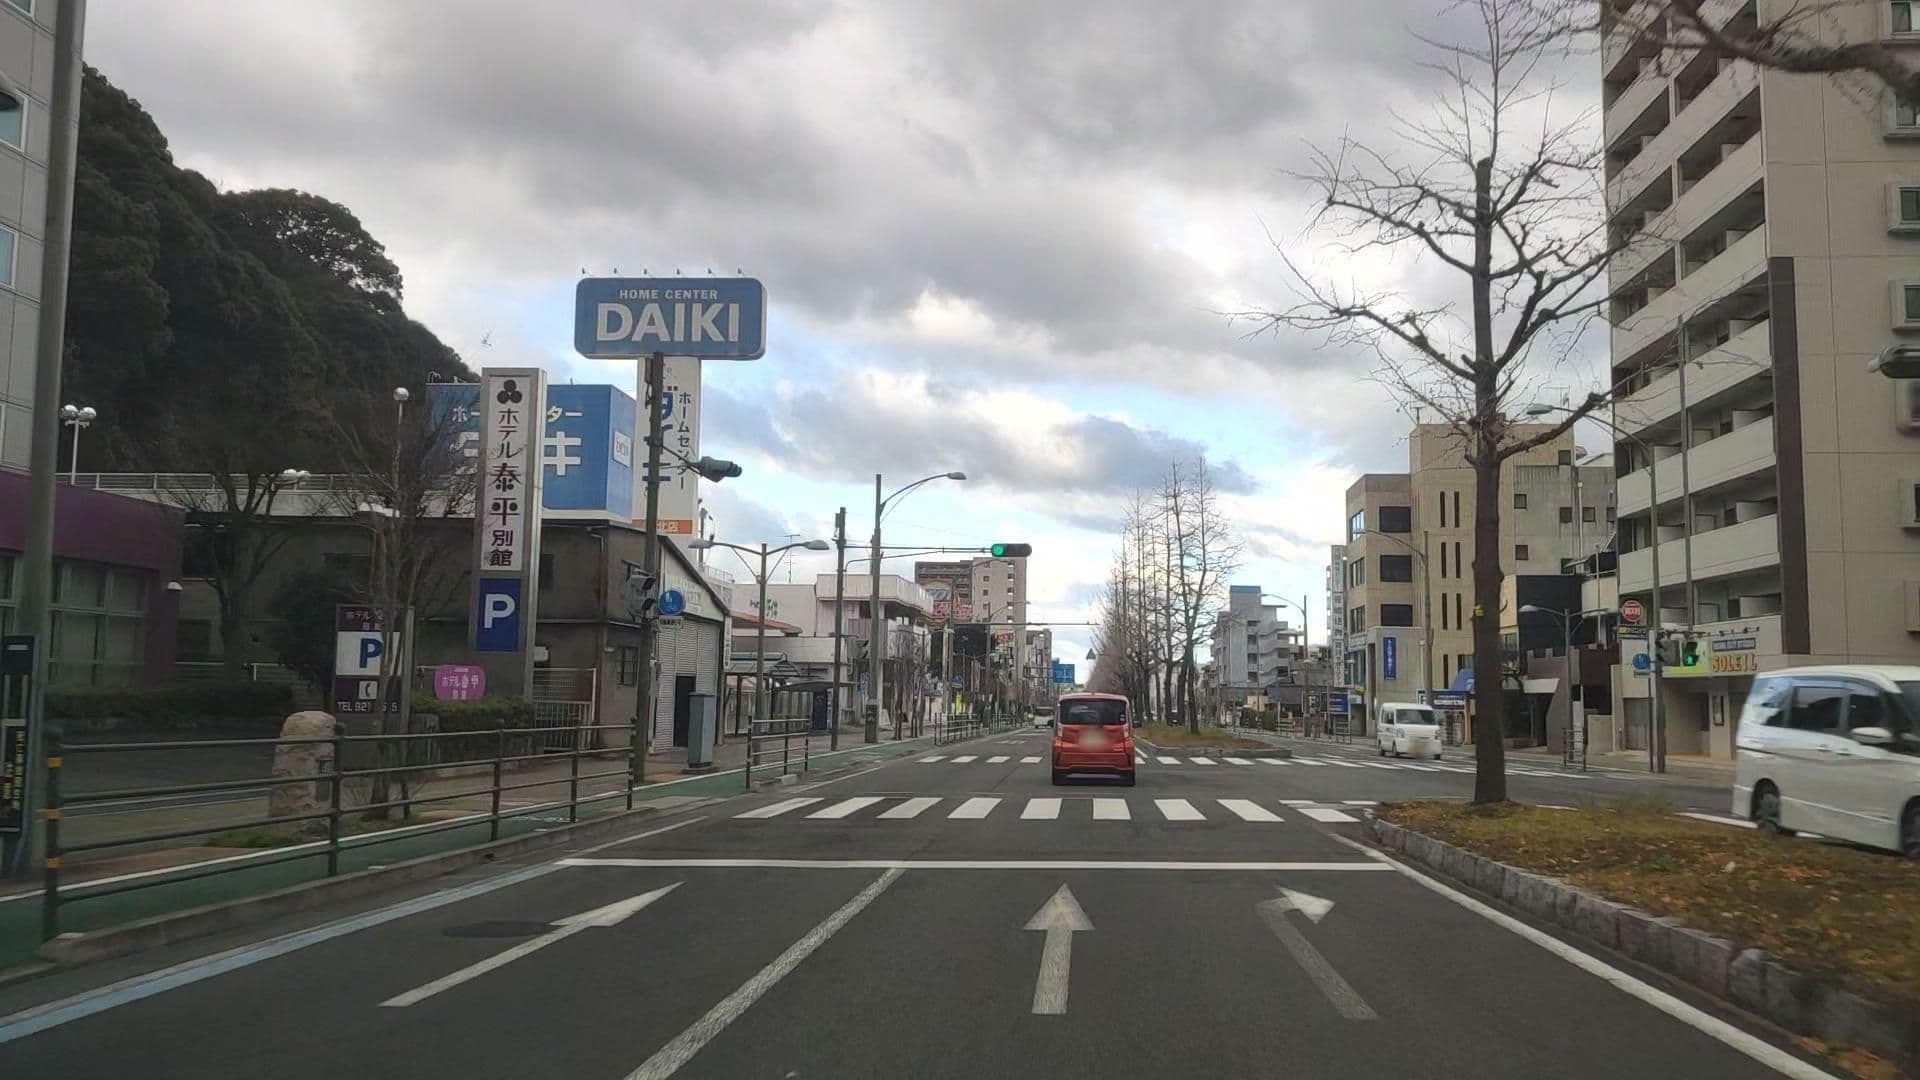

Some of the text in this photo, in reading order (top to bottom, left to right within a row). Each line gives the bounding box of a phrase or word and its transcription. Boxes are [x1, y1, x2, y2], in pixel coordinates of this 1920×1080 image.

[619, 289, 718, 300] HOME CENTER
[596, 302, 740, 342] DAIKI
[483, 593, 516, 630] P
[359, 636, 383, 668] P
[1711, 653, 1758, 673] SOLEIL
